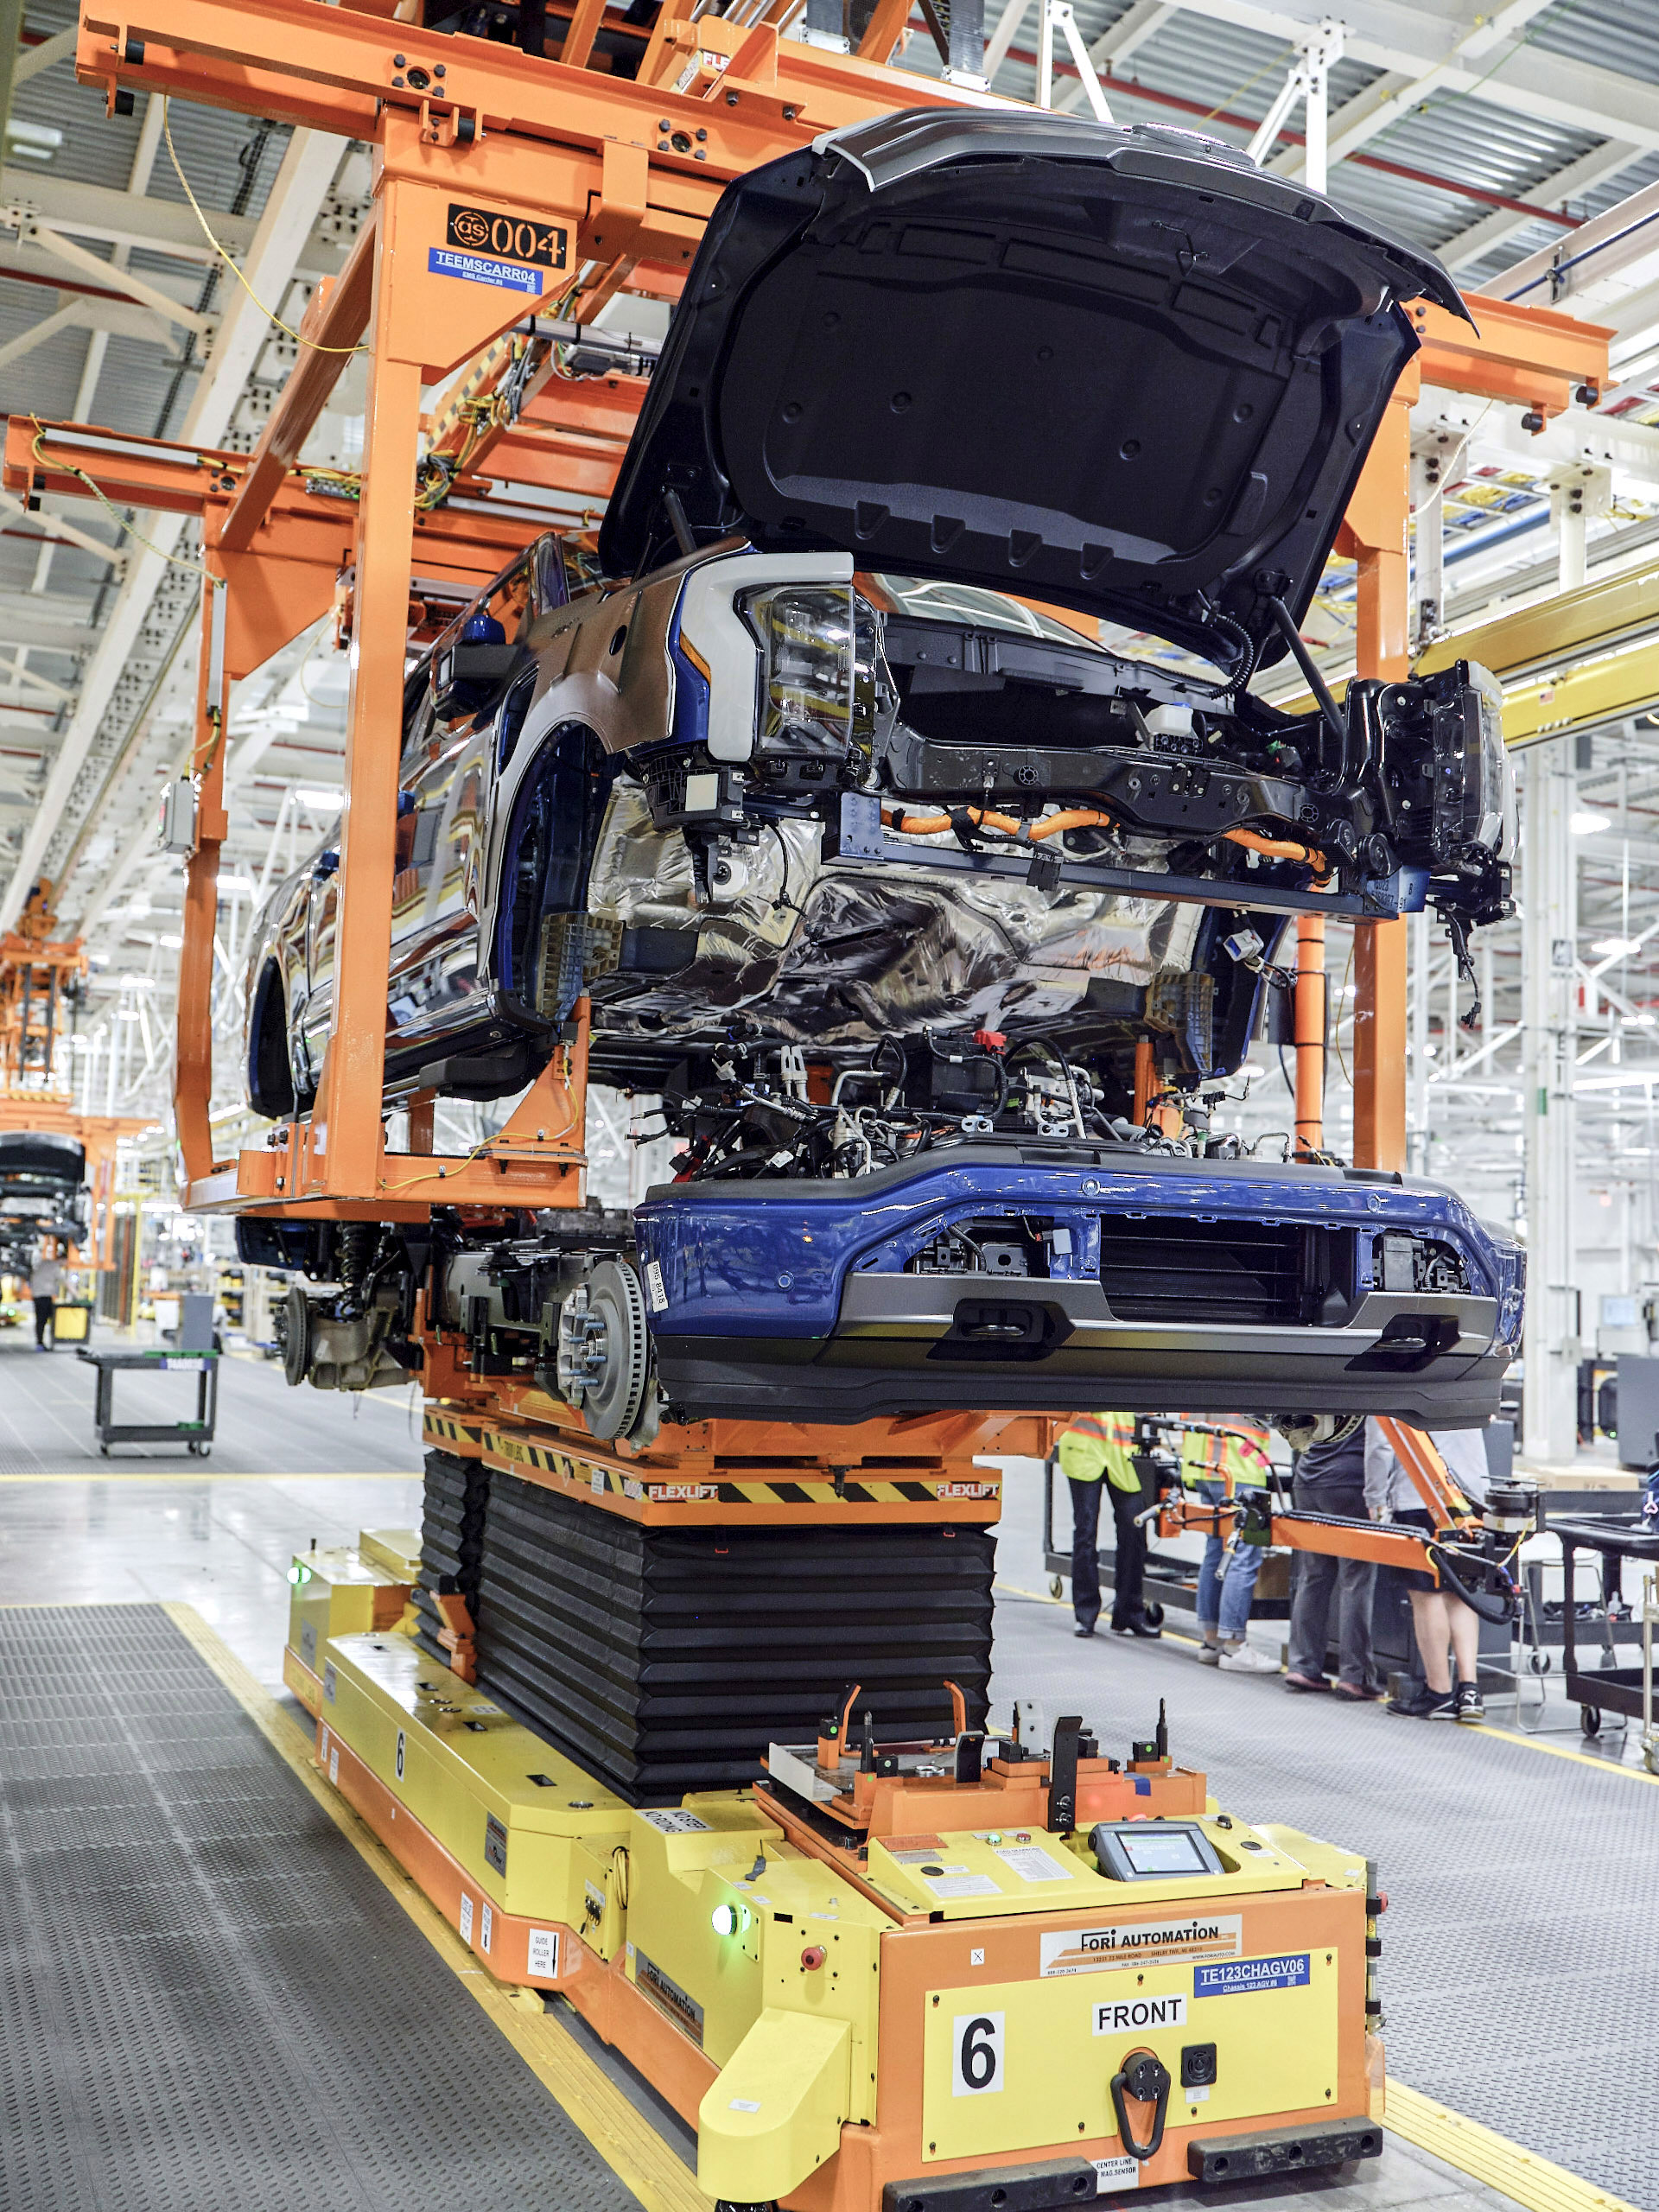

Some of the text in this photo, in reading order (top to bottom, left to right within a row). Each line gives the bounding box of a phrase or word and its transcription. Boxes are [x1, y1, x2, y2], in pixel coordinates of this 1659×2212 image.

[492, 218, 562, 264] 004
[436, 251, 536, 283] TEEMSCARR04
[649, 1484, 718, 1498] FLEXLIFT
[937, 1484, 1000, 1497] FLEXLIFT
[397, 1732, 404, 1777] 6
[536, 1936, 549, 1946] GUIDE
[533, 1948, 550, 1957] ROLLER
[535, 1960, 546, 1968] HERE
[1201, 1958, 1305, 1983] TE123CHAGV06
[1098, 1999, 1182, 2030] FRONT
[961, 2017, 996, 2089] 6
[1096, 2160, 1118, 2169] CENTER
